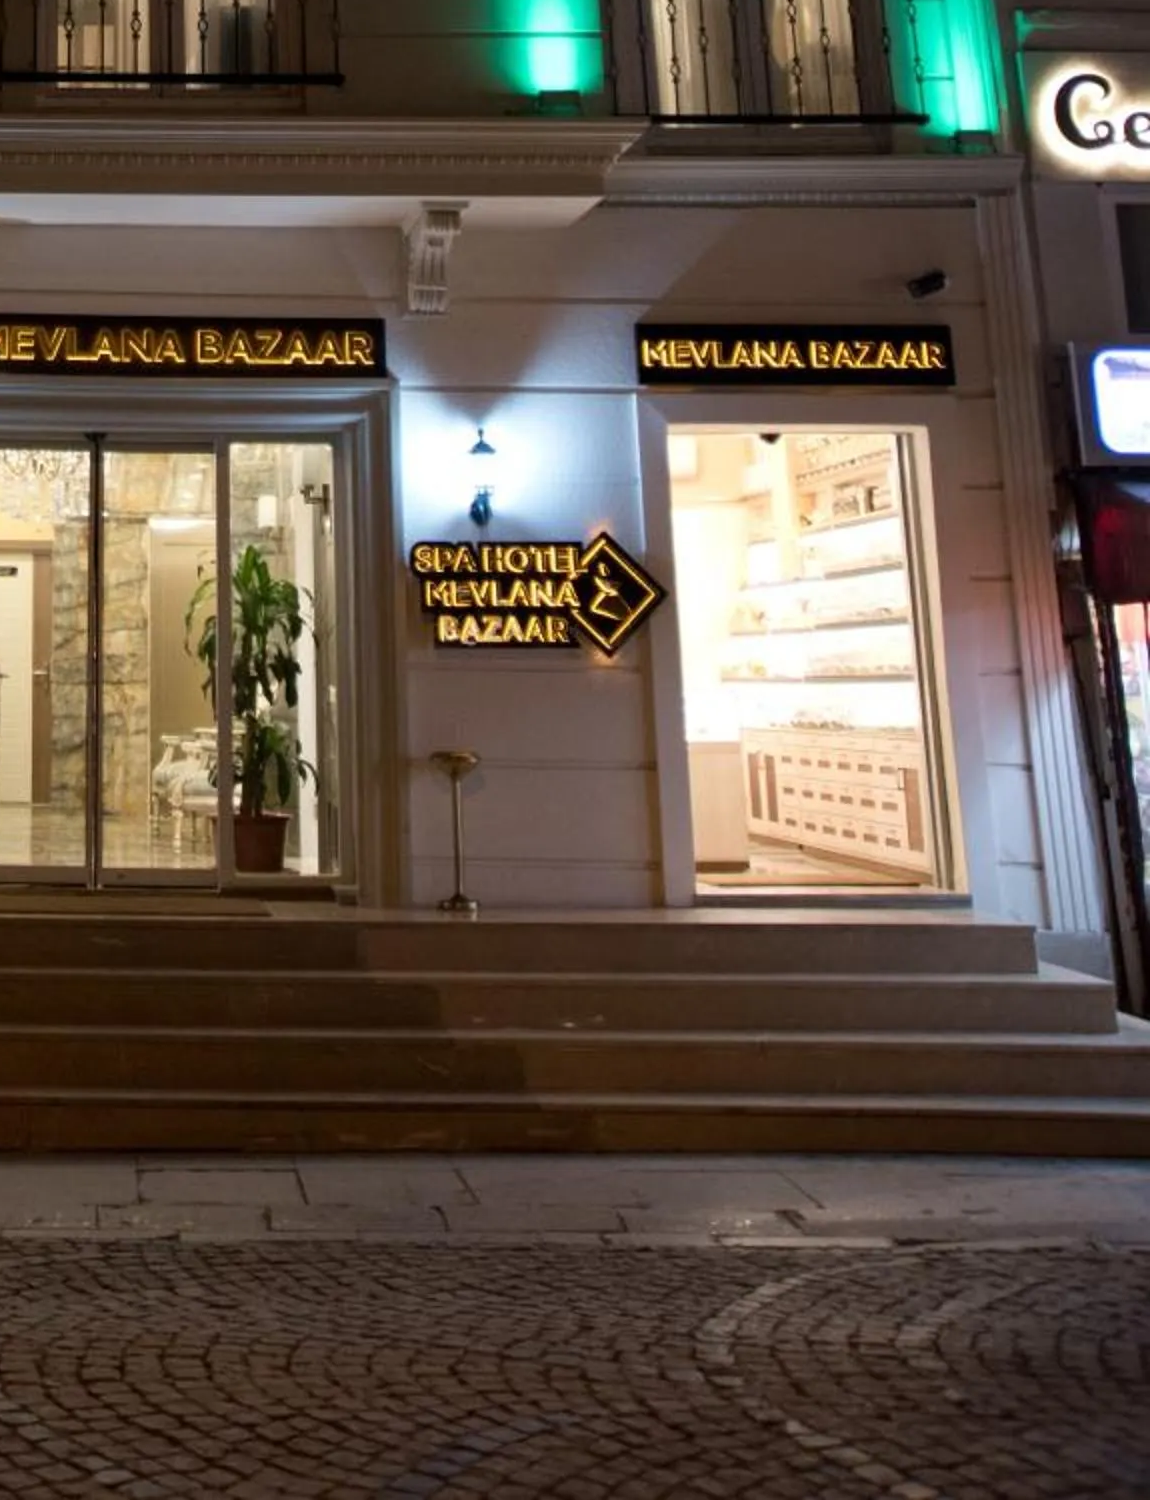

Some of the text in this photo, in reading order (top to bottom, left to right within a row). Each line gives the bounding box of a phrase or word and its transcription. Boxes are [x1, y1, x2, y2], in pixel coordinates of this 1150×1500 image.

[194, 328, 374, 365] BAZAAR
[641, 340, 946, 369] MEVLANA BAZAAR
[414, 545, 588, 574] SPA HOTEL
[425, 579, 580, 607] MEVLANA
[437, 614, 570, 644] BAZAAR
